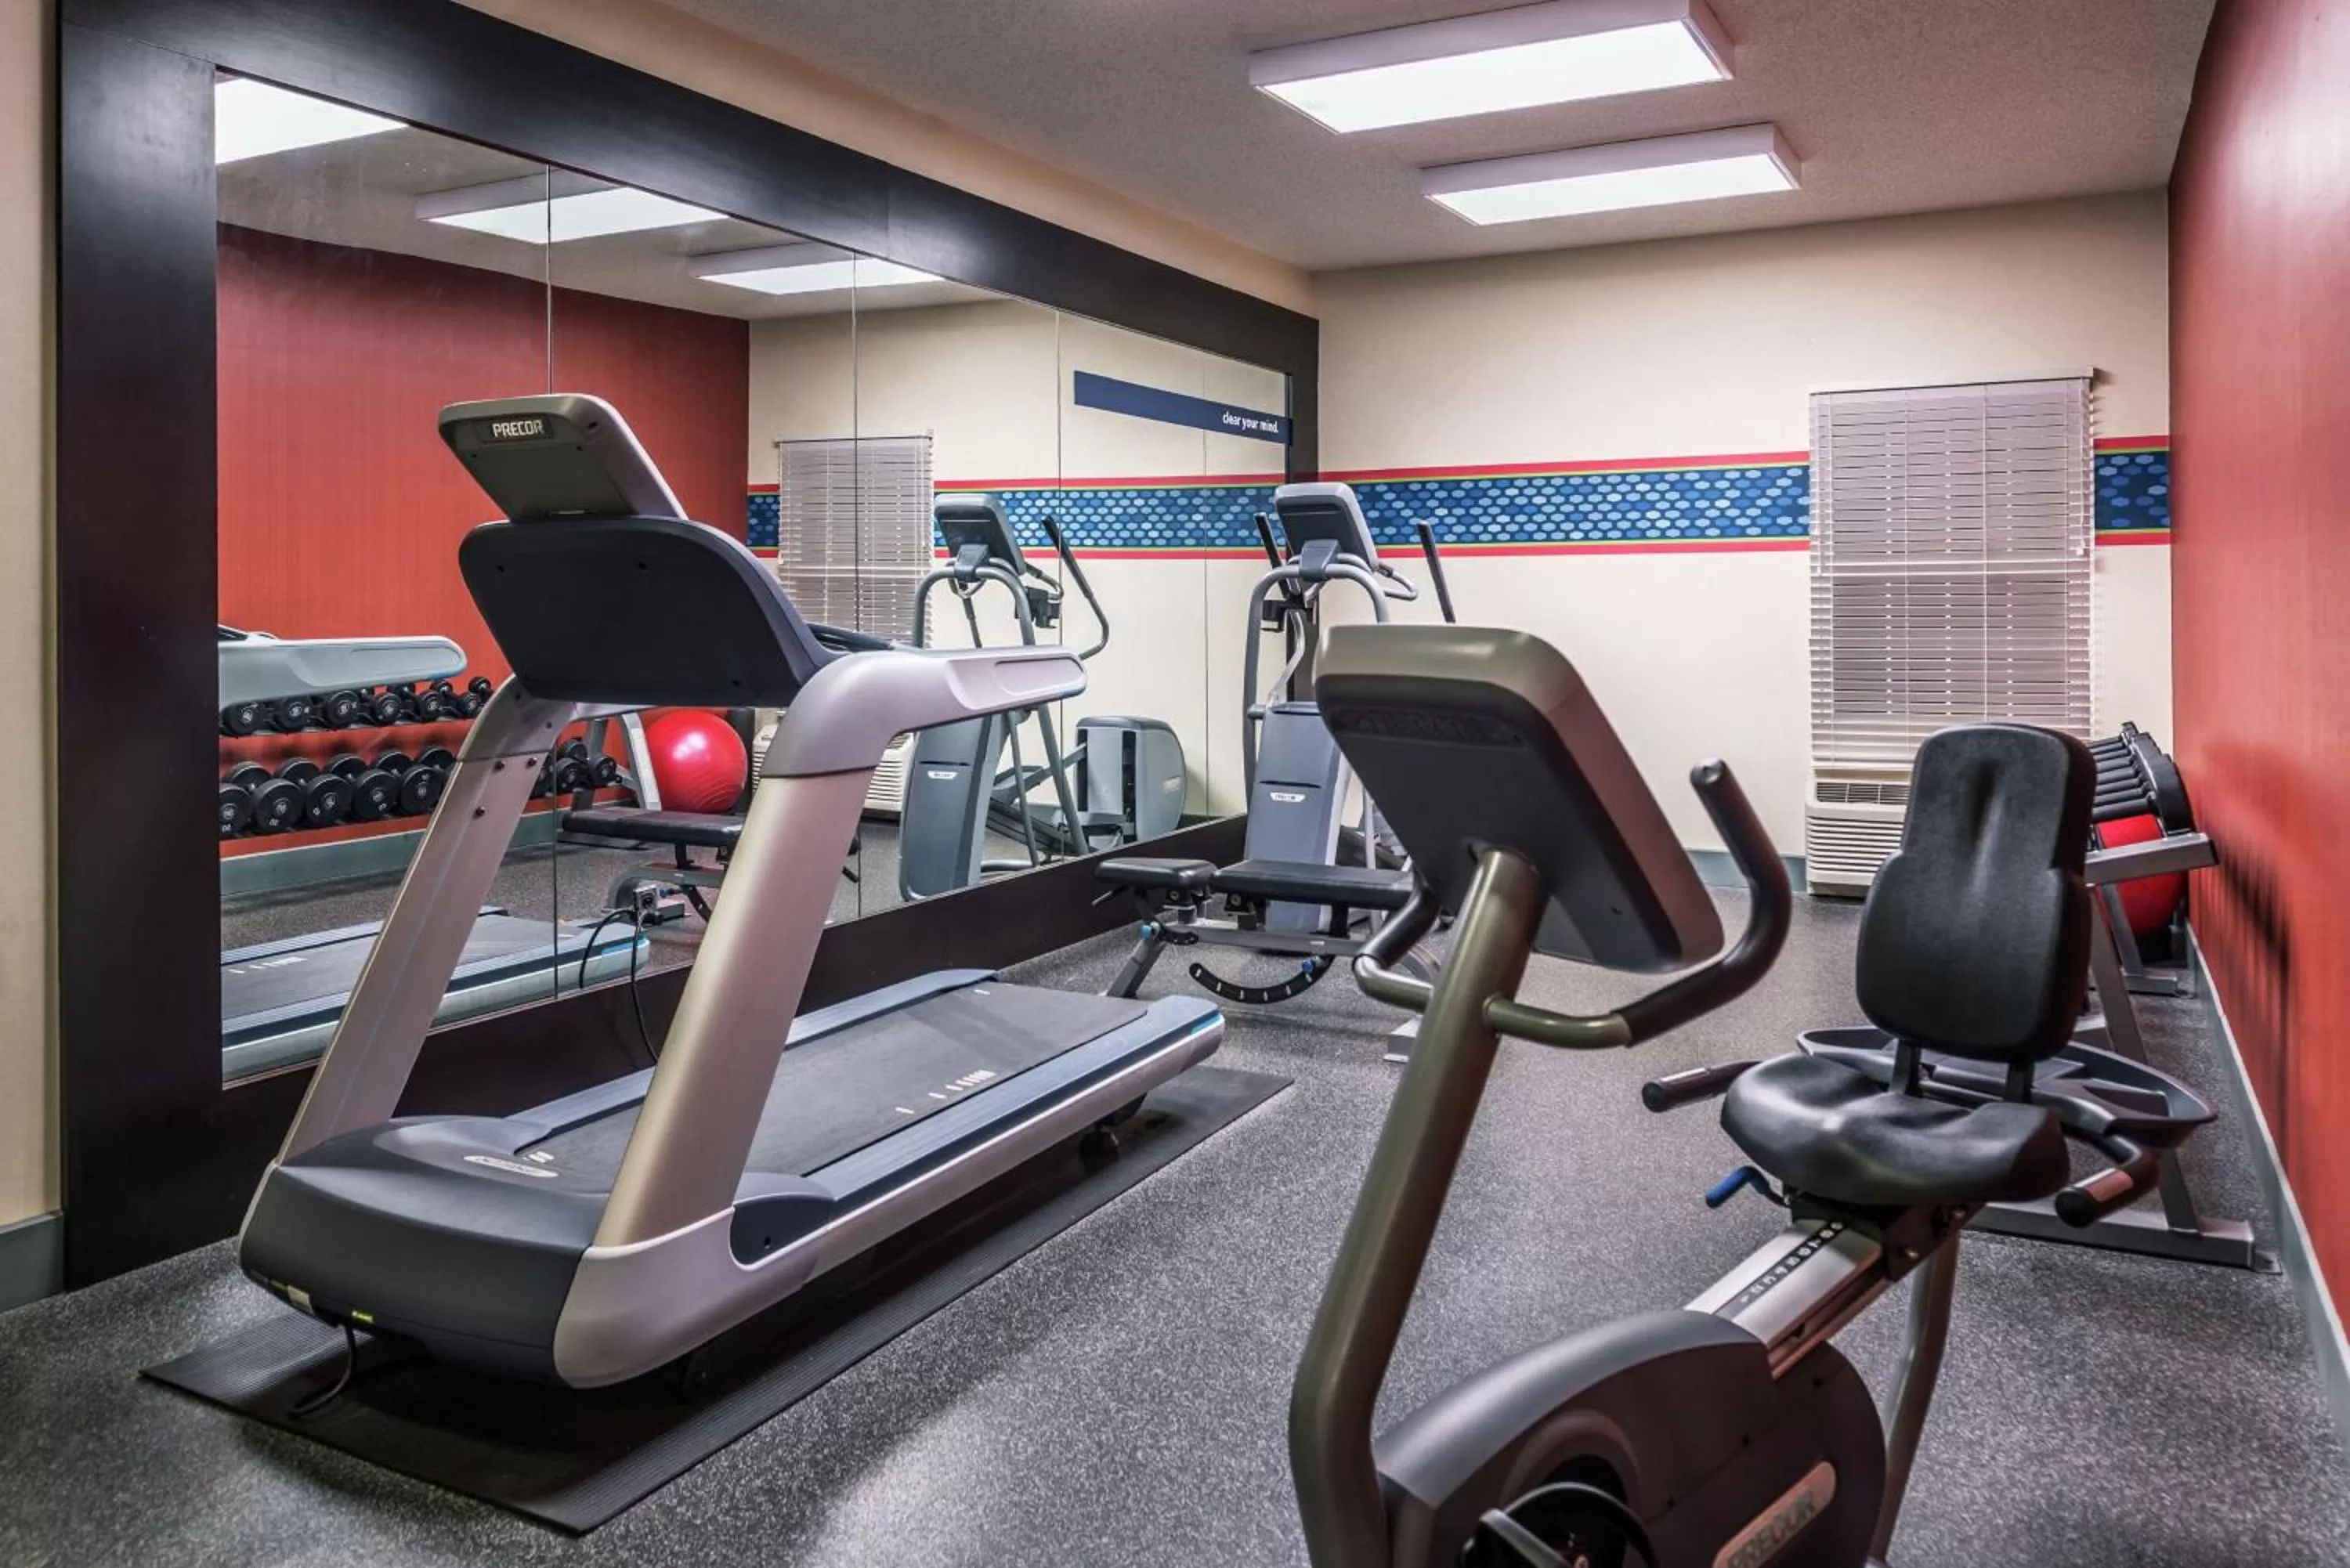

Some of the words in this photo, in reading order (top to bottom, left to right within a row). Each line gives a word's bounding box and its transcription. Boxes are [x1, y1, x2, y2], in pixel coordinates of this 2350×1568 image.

[492, 419, 544, 438] PRECOR
[1223, 410, 1241, 425] clear
[1242, 417, 1258, 431] your
[1259, 420, 1278, 433] mind.
